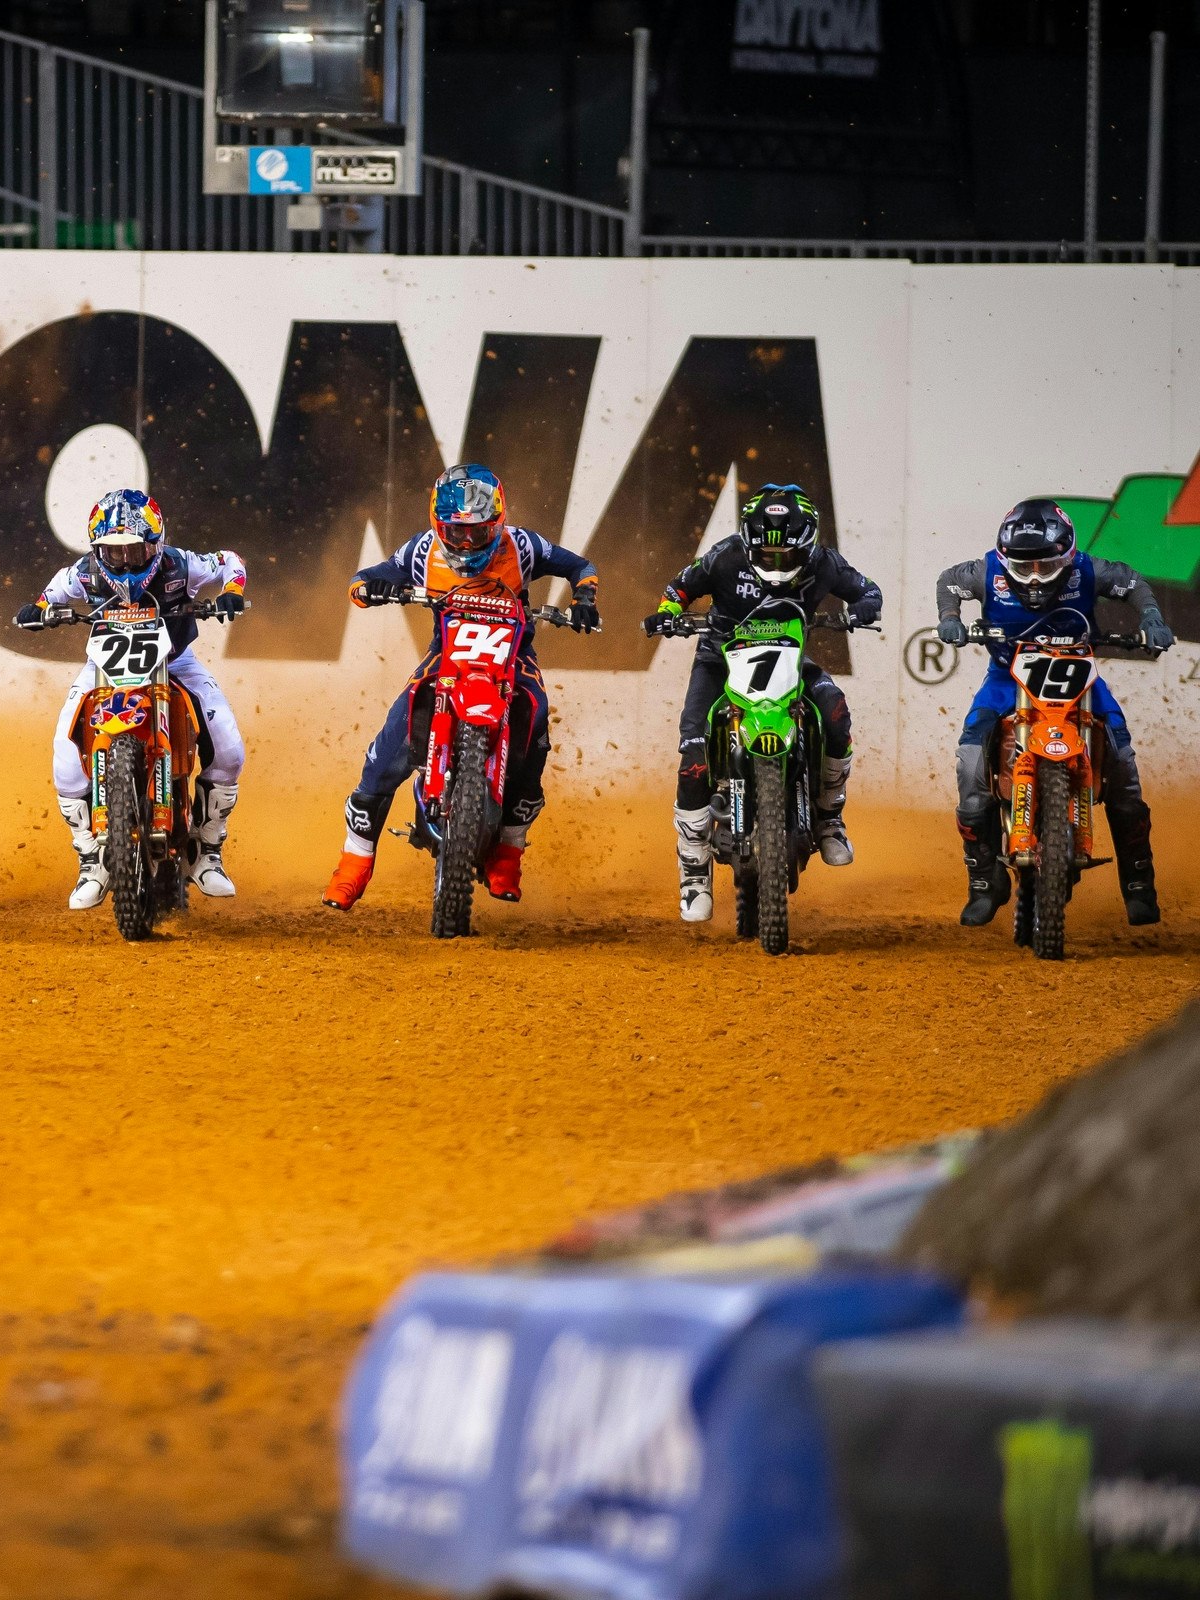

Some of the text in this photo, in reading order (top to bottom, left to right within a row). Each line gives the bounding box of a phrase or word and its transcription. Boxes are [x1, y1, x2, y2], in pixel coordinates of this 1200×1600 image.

[452, 594, 514, 608] RENTHAL
[102, 632, 160, 677] 25
[449, 623, 512, 666] 94
[746, 650, 782, 694] 1
[1022, 657, 1092, 700] 19
[98, 750, 106, 806] DUNOP
[424, 731, 436, 785] DUNLOP
